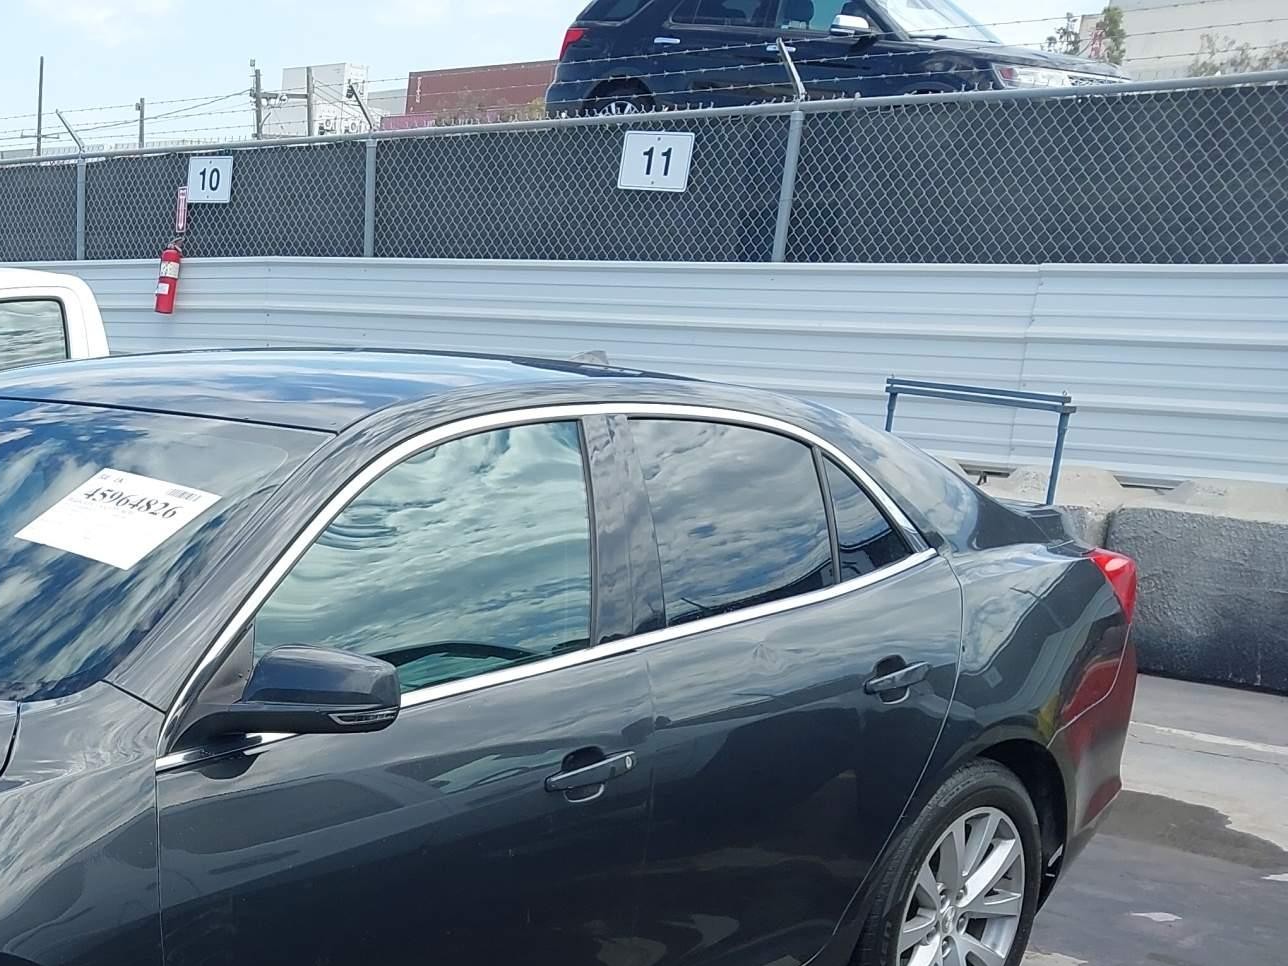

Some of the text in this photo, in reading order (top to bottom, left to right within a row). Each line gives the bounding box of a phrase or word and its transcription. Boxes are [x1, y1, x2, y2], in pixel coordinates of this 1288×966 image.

[642, 145, 673, 177] 11
[199, 167, 220, 191] 10
[83, 487, 185, 519] 45964826
